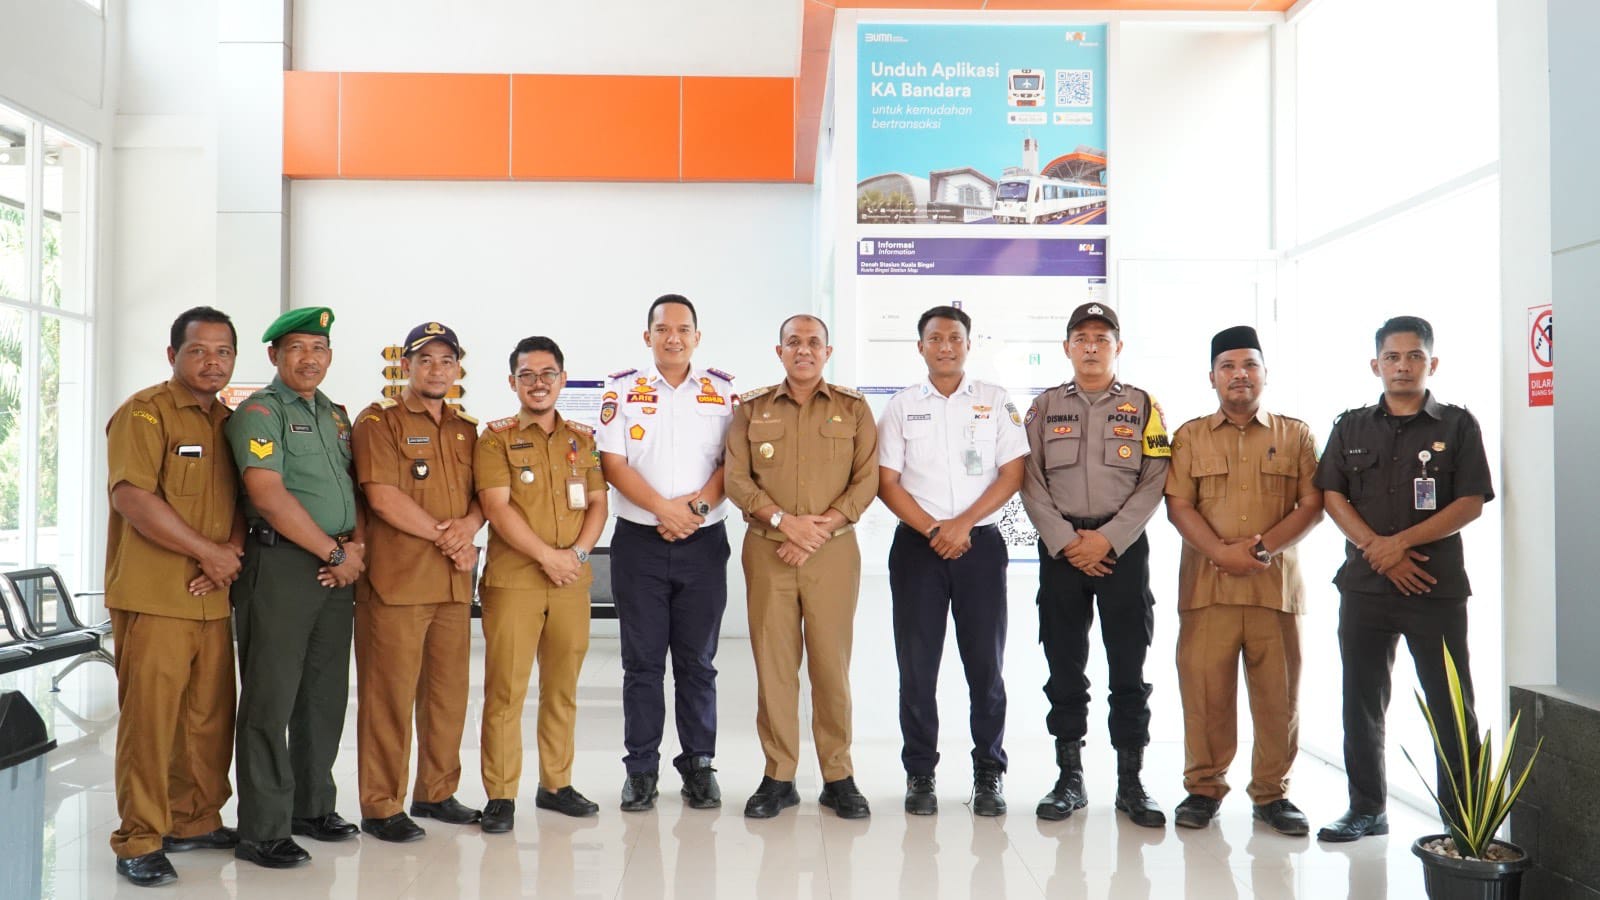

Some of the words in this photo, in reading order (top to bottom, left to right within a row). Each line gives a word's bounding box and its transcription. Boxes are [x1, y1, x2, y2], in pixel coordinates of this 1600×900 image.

[871, 61, 927, 77] Unduh
[931, 62, 1000, 80] Aplikasi
[871, 82, 897, 97] KA
[901, 82, 972, 97] Bandara
[871, 104, 903, 115] untuk
[906, 103, 972, 115] kemudahan
[871, 119, 941, 129] bertransaksi
[877, 240, 915, 249] Informasi
[1079, 243, 1095, 252] KAI
[630, 394, 654, 402] ARIE
[1046, 414, 1080, 424] DISWAN.S
[1107, 414, 1141, 425] POLRI
